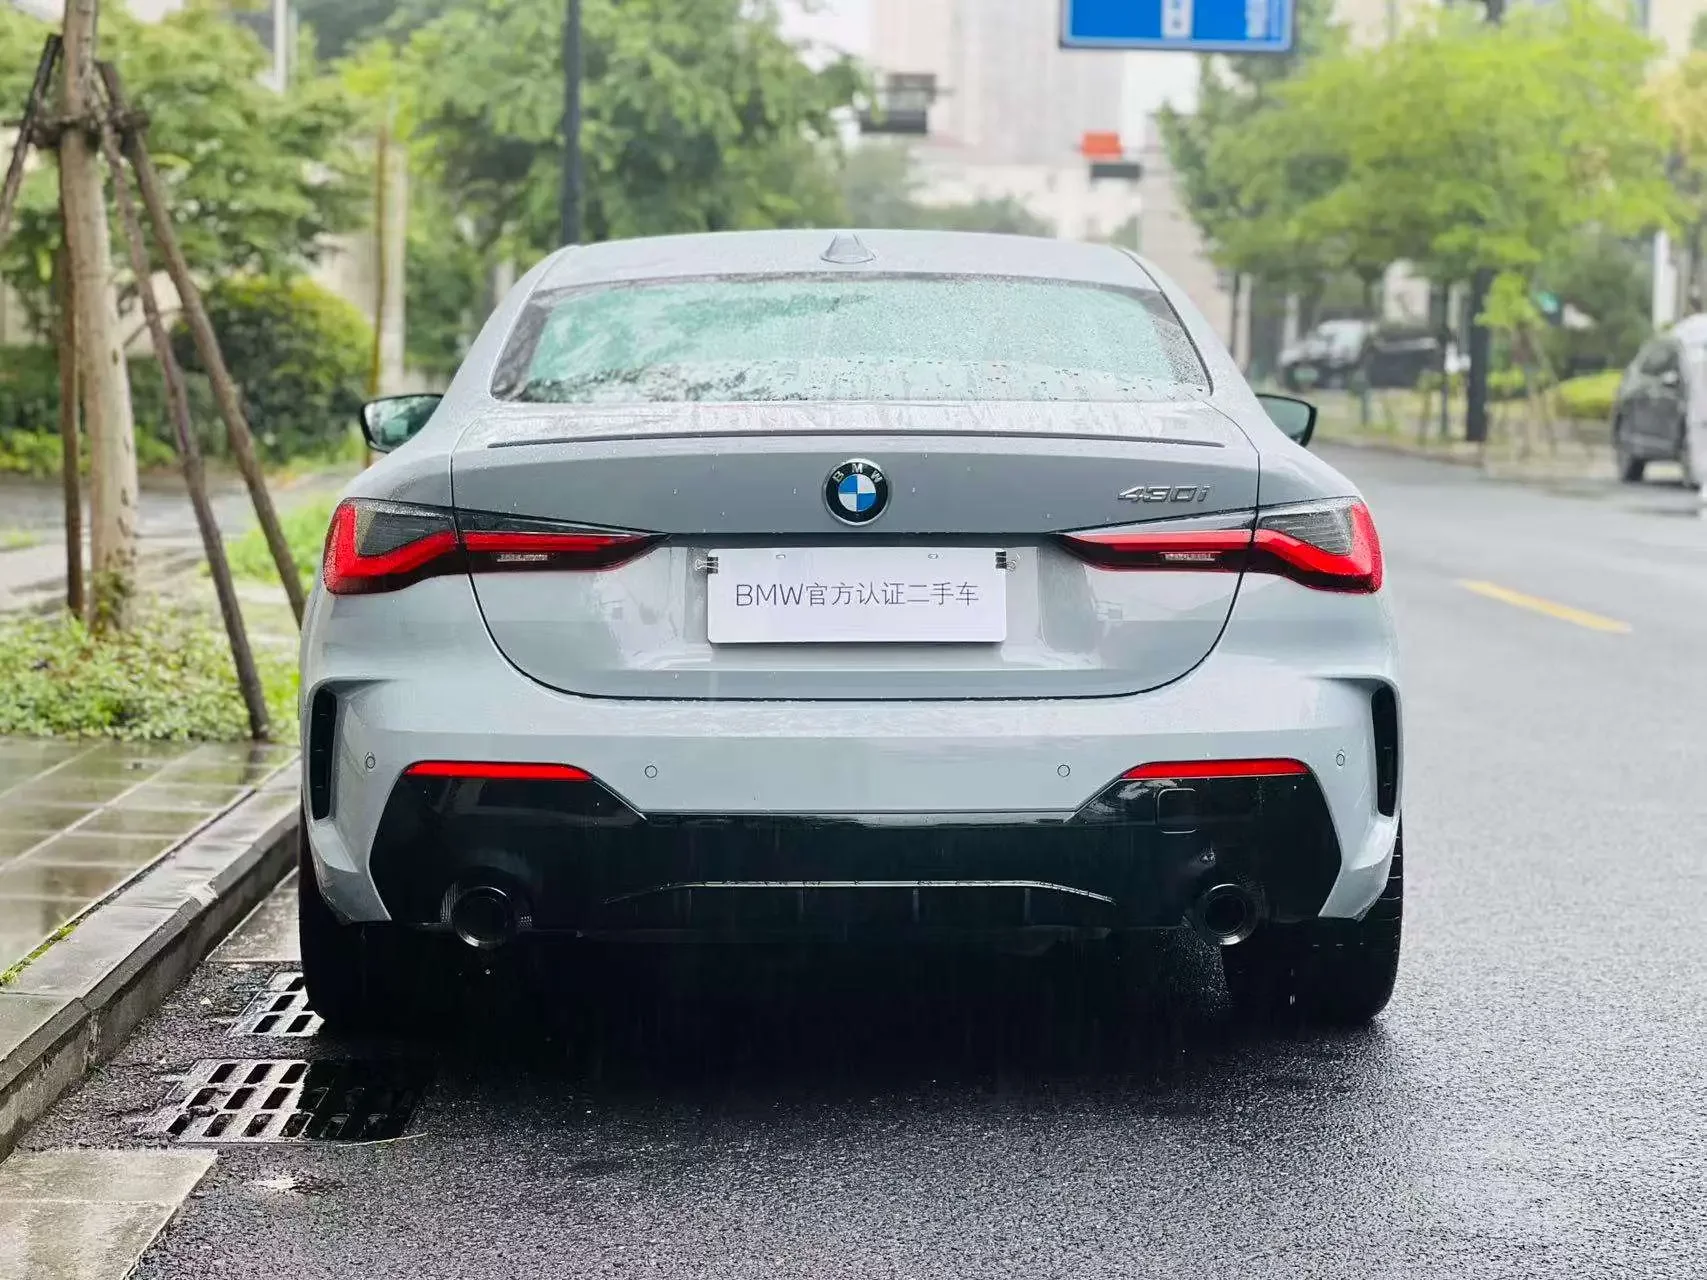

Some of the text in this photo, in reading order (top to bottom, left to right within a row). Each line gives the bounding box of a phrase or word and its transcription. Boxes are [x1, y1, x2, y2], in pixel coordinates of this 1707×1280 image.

[832, 463, 883, 483] BMW
[1118, 485, 1211, 502] 430i
[736, 581, 980, 606] BMW官方认证二手车
